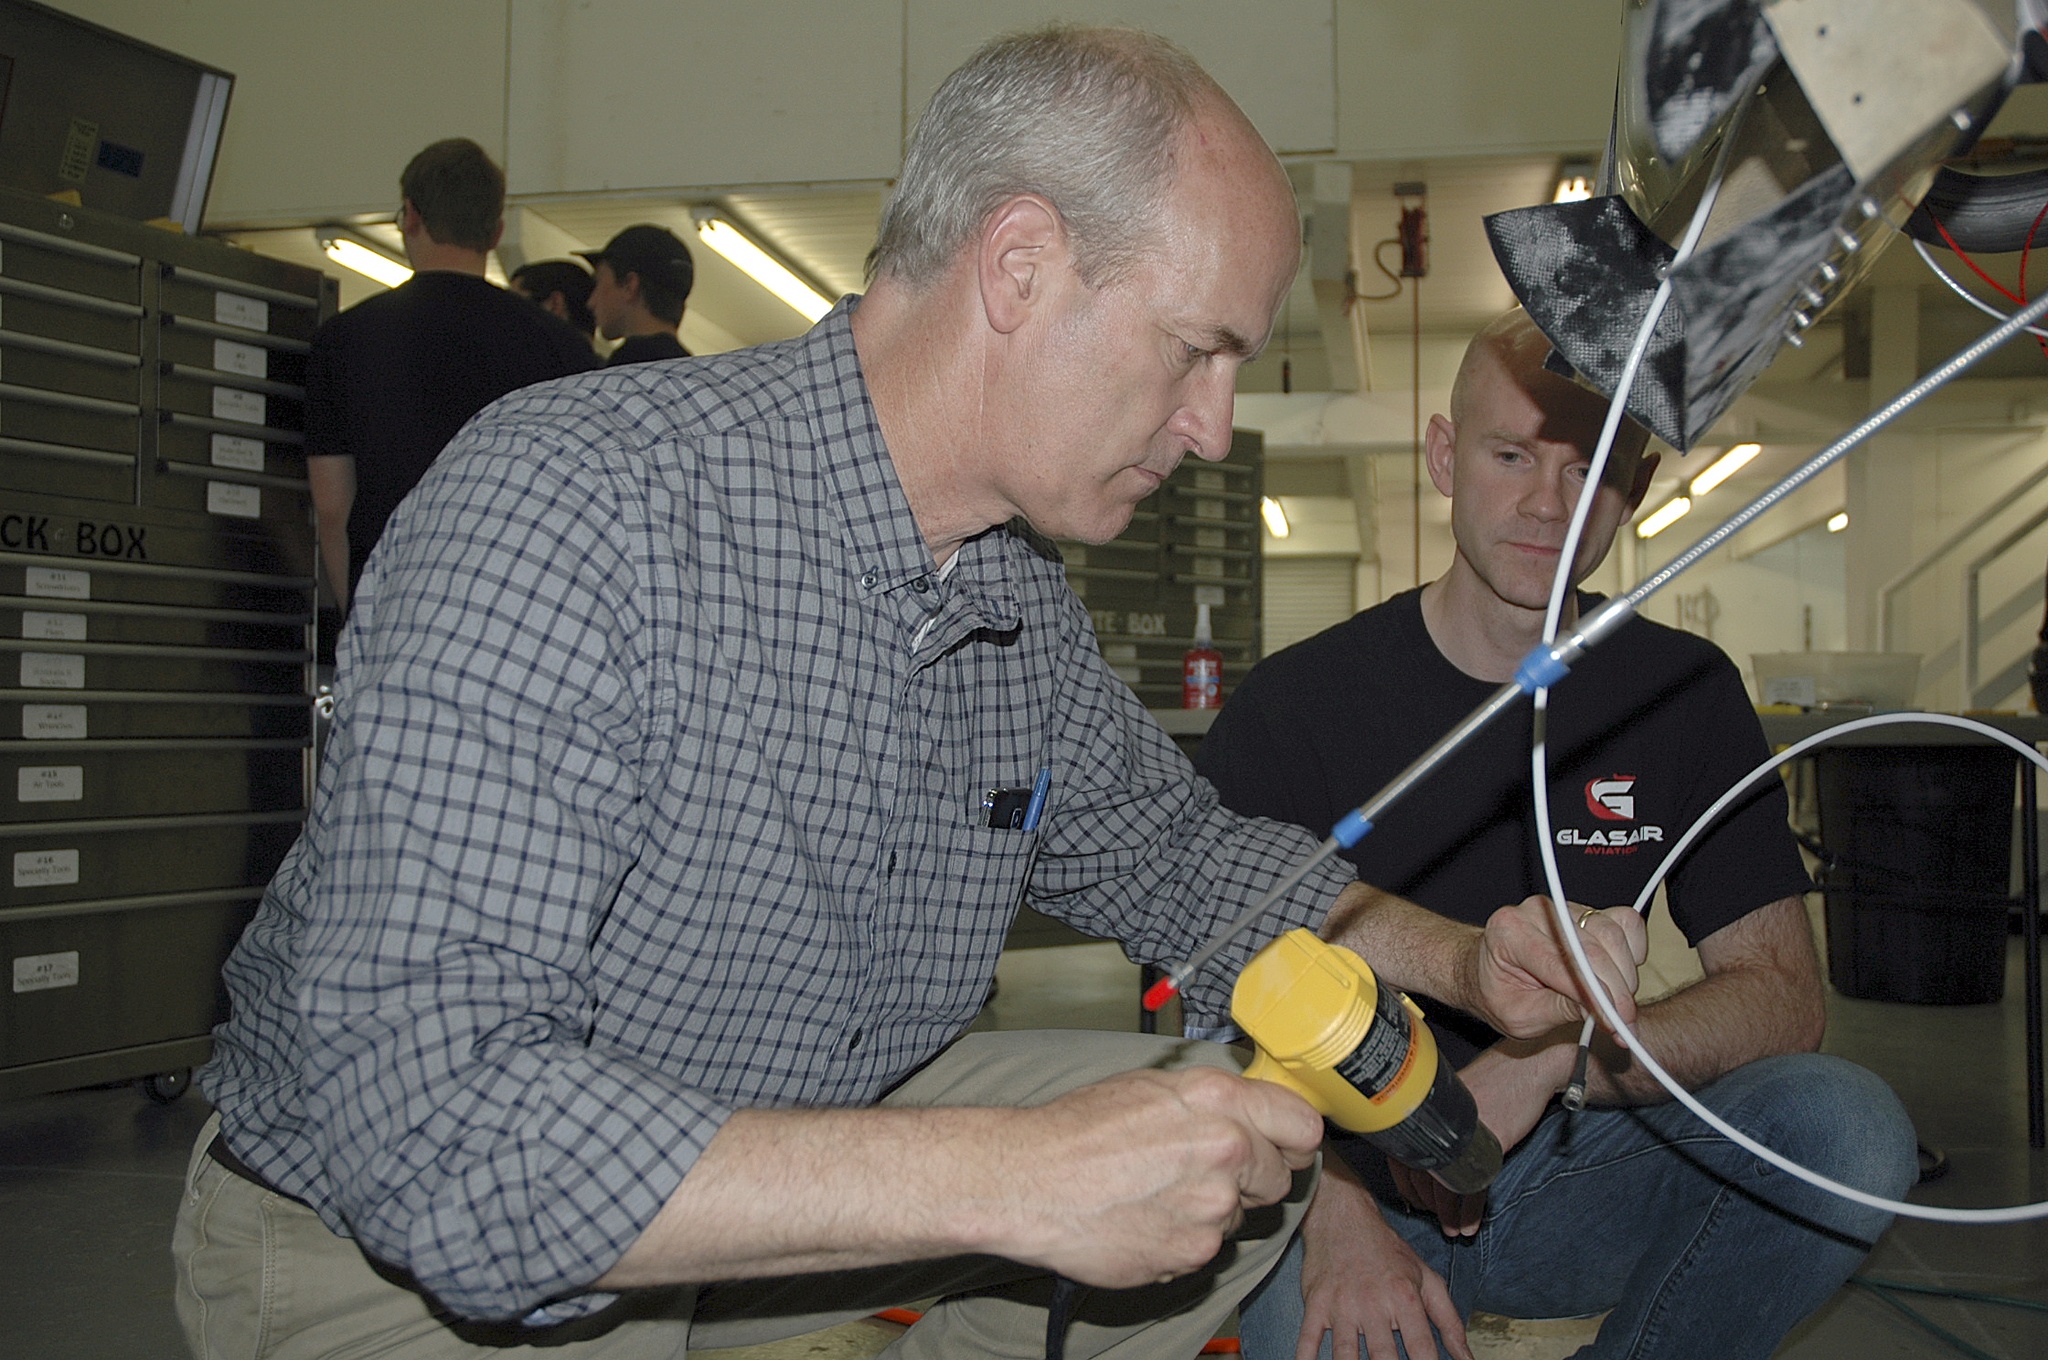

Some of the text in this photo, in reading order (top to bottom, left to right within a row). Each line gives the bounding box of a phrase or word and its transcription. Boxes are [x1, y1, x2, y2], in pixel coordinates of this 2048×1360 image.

[77, 521, 147, 559] BOX
[1127, 612, 1167, 635] BOX
[1556, 826, 1664, 847] GLASAIR
